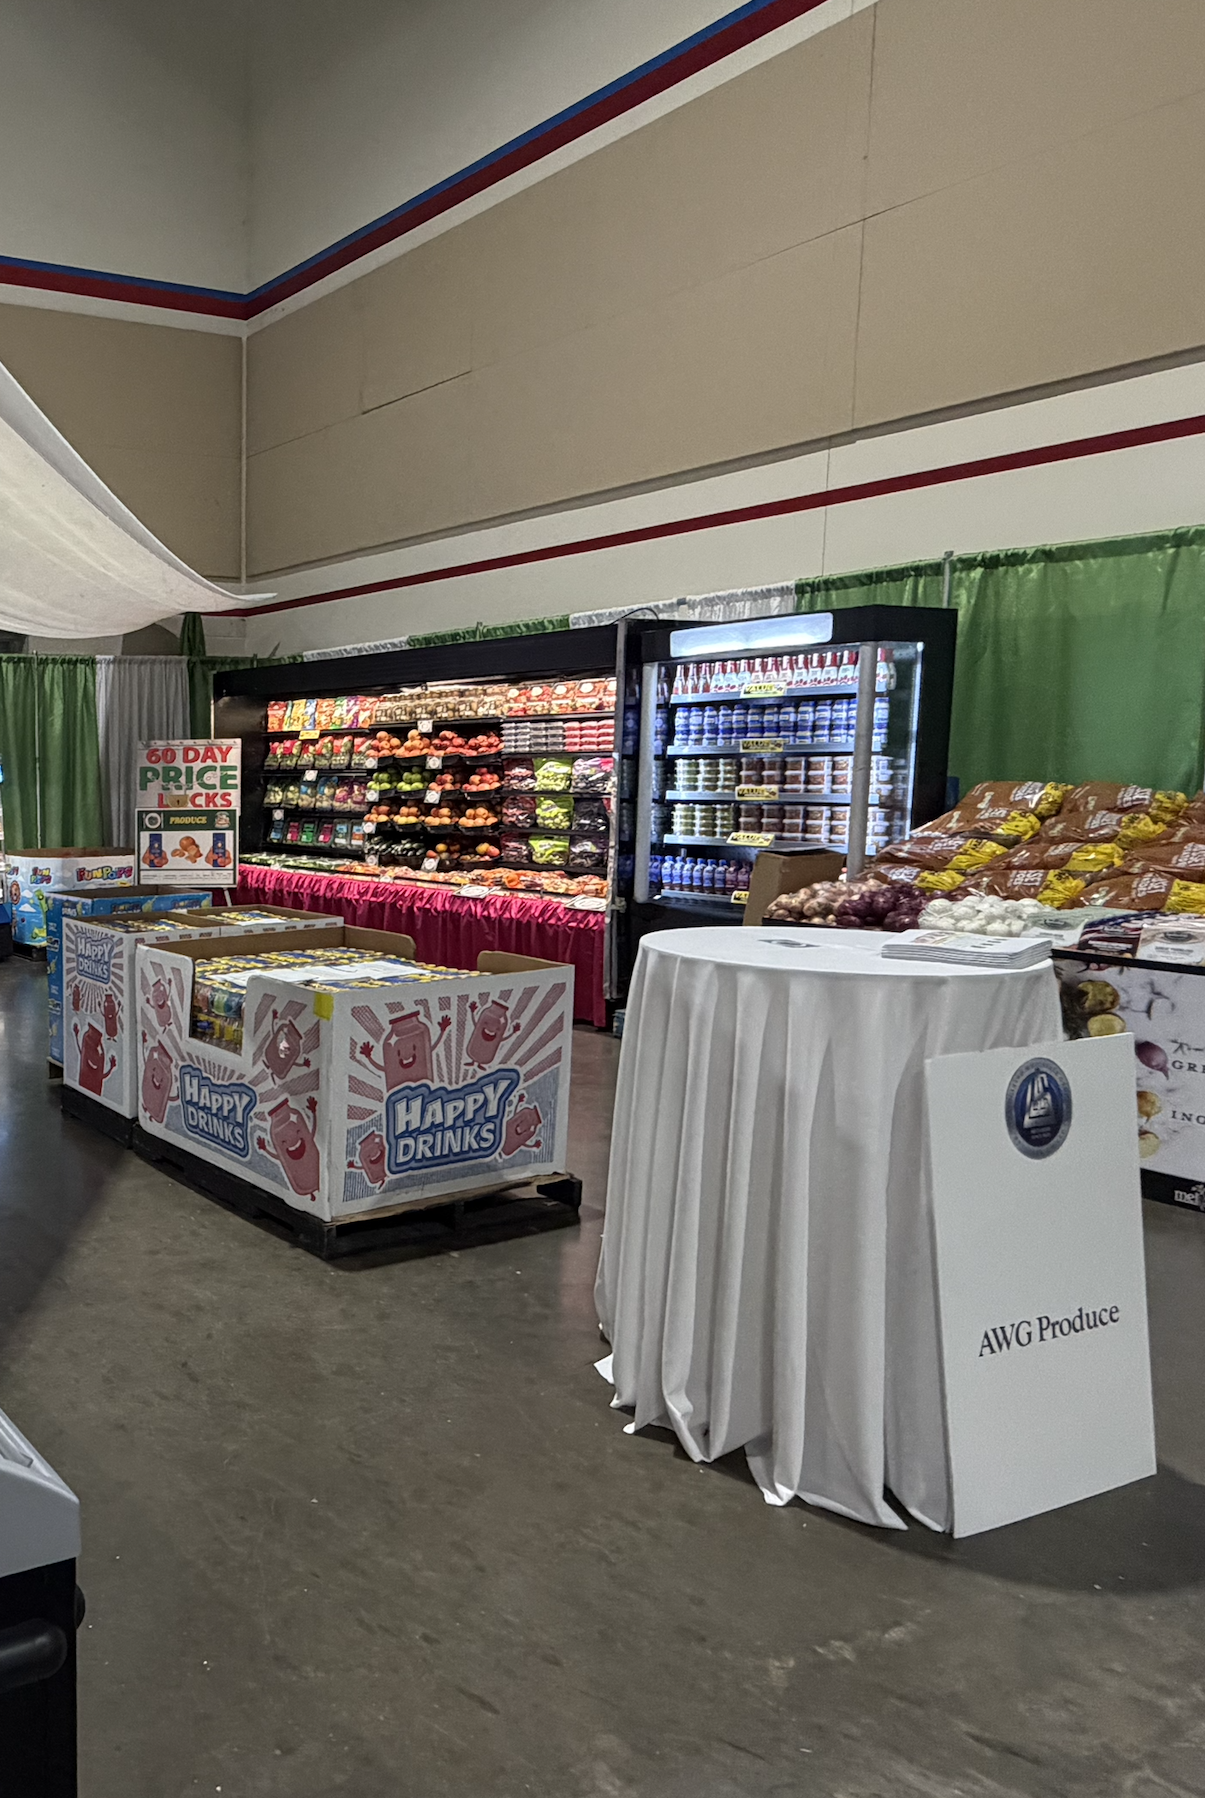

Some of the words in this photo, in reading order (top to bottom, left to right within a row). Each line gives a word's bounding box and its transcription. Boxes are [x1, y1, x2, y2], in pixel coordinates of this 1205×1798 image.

[146, 747, 177, 764] 60
[182, 745, 233, 764] DAY
[139, 765, 239, 791] PRICE
[169, 816, 207, 824] PRODUCE
[77, 937, 112, 962] HAPPY
[78, 957, 109, 979] DRINKS
[183, 1073, 251, 1124] HAPPY
[395, 1079, 512, 1137] HAPPY
[186, 1104, 245, 1149] DRINKS
[396, 1121, 496, 1164] DRINKS
[978, 1320, 1033, 1358] AWG
[1035, 1304, 1121, 1343] Produce
